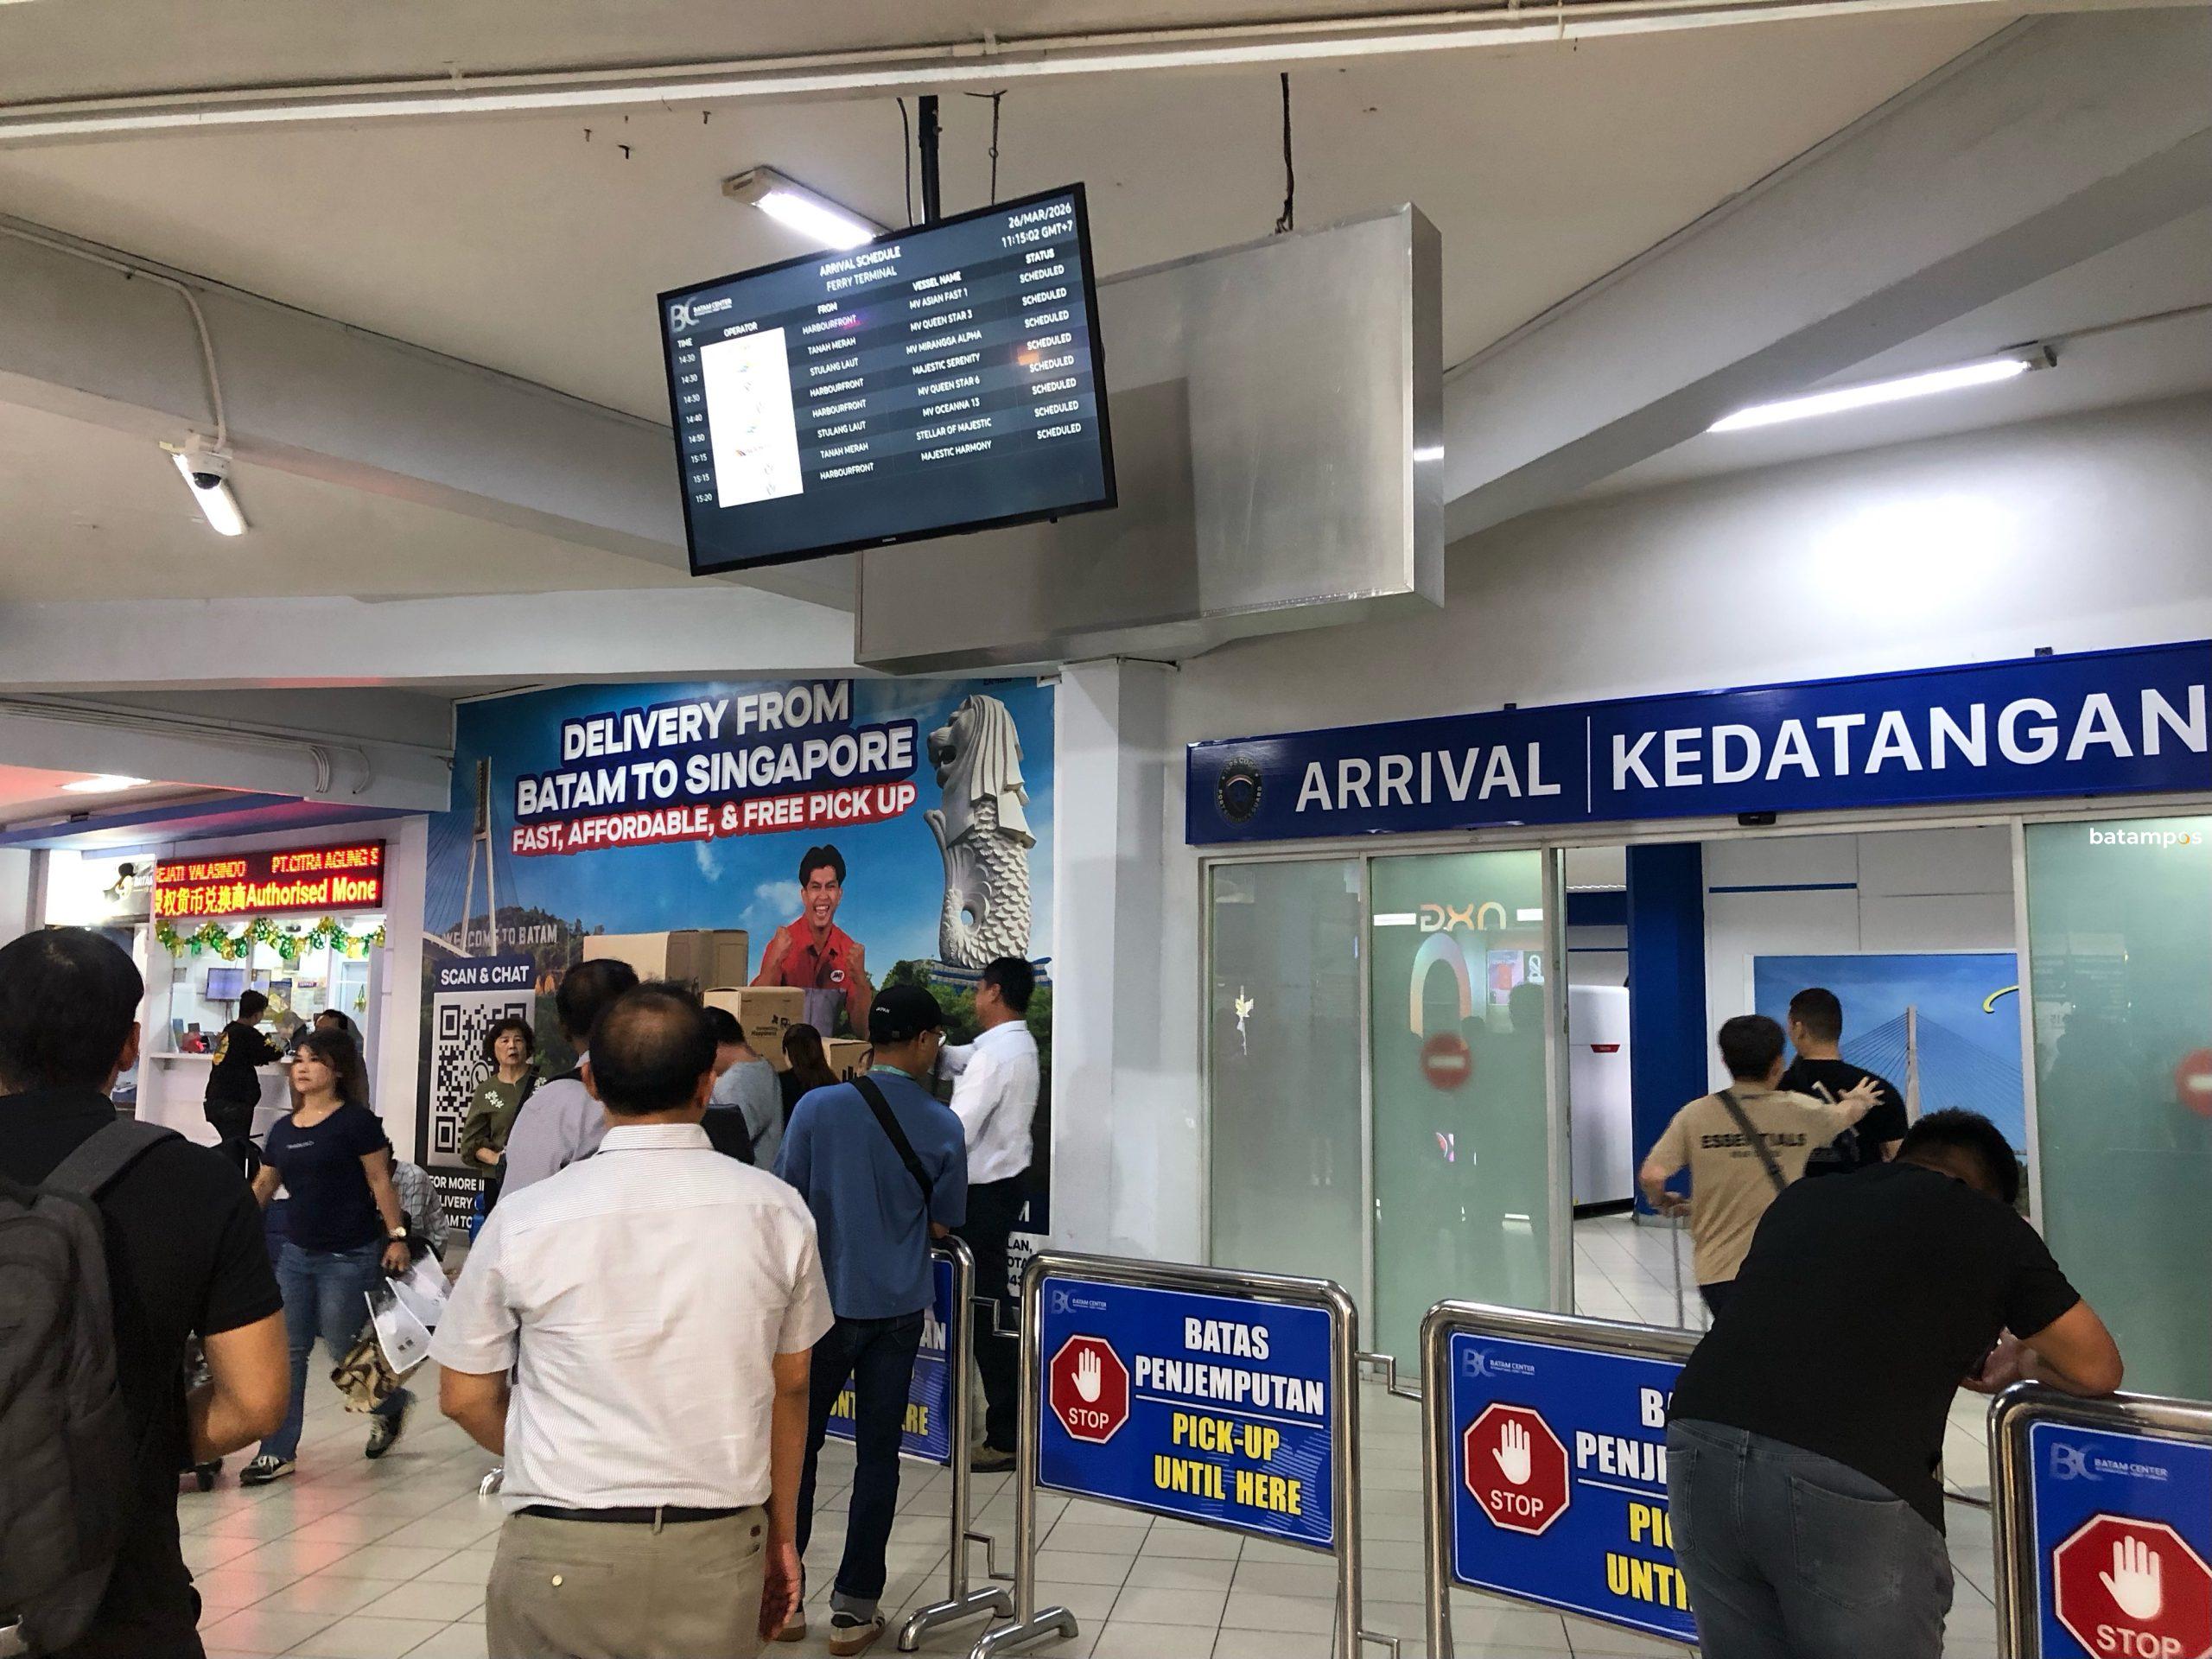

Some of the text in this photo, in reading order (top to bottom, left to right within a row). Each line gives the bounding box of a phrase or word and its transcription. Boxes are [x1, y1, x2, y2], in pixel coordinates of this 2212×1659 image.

[1008, 202, 1072, 229] 26/MAR/2026
[1001, 219, 1073, 248] 11:15:02 GMT+7
[820, 246, 901, 276] ARRIVAL SCHEDULE
[1025, 248, 1055, 264] STATUS
[826, 265, 898, 292] FERRY TERMINAL
[912, 270, 962, 291] VESSEL NAME
[1020, 264, 1065, 283] SCHEDULED
[909, 287, 968, 310] MV ASIAN FAST 1
[1021, 287, 1067, 307] SCHEDULED
[817, 302, 838, 315] FROM
[723, 321, 759, 337] OPERATOR
[802, 314, 857, 335] HARBOURFRONT
[910, 308, 973, 333] MV QUEEN STAR 3
[1024, 310, 1070, 329] SCHEDULED
[677, 338, 693, 348] TIME
[807, 336, 856, 356] TANAH MERAH
[906, 329, 982, 355] MV MIRANGGA ALPHA
[1027, 332, 1072, 351] SCHEDULED
[809, 357, 859, 377] STULANG LAUT
[912, 353, 981, 376] MAJESTIC SERENITY
[1029, 354, 1075, 373] SCHEDULED
[810, 378, 864, 397] HARBOURFRONT
[918, 374, 981, 397] MV QUEEN STAR 6
[1032, 377, 1077, 396] SCHEDULED
[812, 399, 867, 418] HARBOURFRONT
[922, 397, 981, 417] MV OCEANNA 13
[1033, 399, 1079, 418] SCHEDULED
[817, 420, 867, 439] STULANG LAUT
[916, 417, 993, 442] STELLAR OF MAJESTIC
[1036, 423, 1082, 440] SCHEDULED
[820, 442, 869, 460] TANAH MERAH
[920, 440, 992, 461] MAJESTIC HARMONY
[820, 462, 874, 480] HARBOURFRONT
[563, 681, 849, 762] DELIVERY FROM
[1294, 683, 2209, 815] ARRIVAL KEDATANGAN
[518, 727, 913, 817] BATAM TO SINGAPORE
[512, 784, 917, 854] FAST, AFFORDABLE, & FREE PICK UP
[518, 925, 557, 945] BATAM
[441, 965, 530, 985] SCAN & CHAT
[448, 1177, 477, 1191] MORE
[439, 1194, 474, 1210] LIVERY
[1185, 1316, 1269, 1360] BATAS
[1135, 1354, 1325, 1416] PENJEMPUTAN
[1068, 1407, 1109, 1430] STOP
[1173, 1412, 1281, 1462] PICK-UP
[2094, 1458, 2128, 1470] BATAM
[2129, 1463, 2169, 1477] CENTER
[1154, 1454, 1303, 1516] UNTIL HERE
[1490, 1489, 1544, 1517] STOP
[1605, 1551, 1694, 1611] UNTI
[2096, 1624, 2183, 1659] STOP
